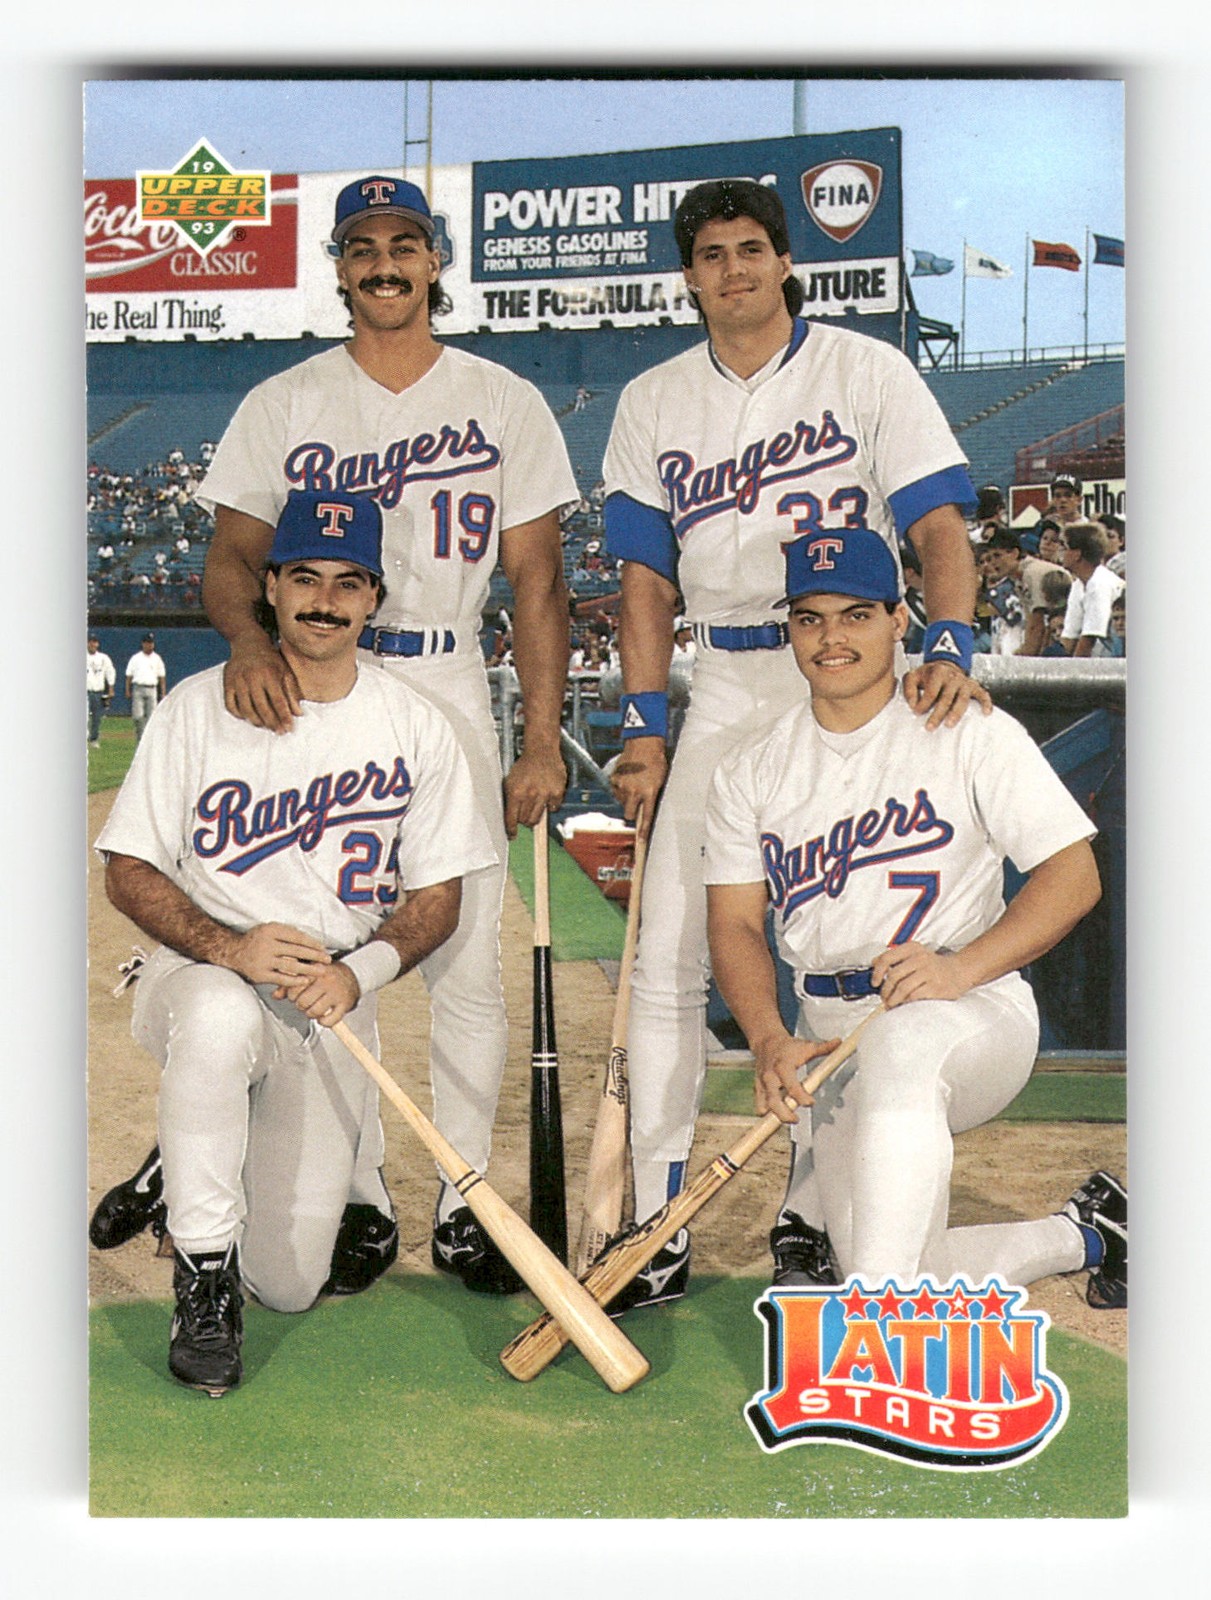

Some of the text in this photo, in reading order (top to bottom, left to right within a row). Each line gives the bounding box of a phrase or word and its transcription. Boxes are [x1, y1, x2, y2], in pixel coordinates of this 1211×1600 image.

[192, 161, 215, 173] 19
[143, 178, 264, 195] UPPER
[361, 179, 396, 206] T
[813, 183, 871, 208] FINA
[483, 185, 623, 231] POWER
[191, 222, 215, 235] 93
[483, 230, 648, 258] GENESIS GASOLINES
[170, 251, 257, 276] CLASSIC
[483, 251, 648, 272] FROM YOUR FRIENDS AT FINA
[114, 300, 158, 330] Real
[162, 299, 226, 334] Thing.
[483, 289, 530, 319] THE
[537, 282, 667, 317] FORMULA
[284, 418, 500, 510] Rangers
[656, 409, 858, 526] Rangers
[316, 502, 354, 537] T
[430, 489, 497, 564] 19
[807, 537, 844, 572] T
[192, 755, 415, 866] Rangers
[760, 788, 955, 914] Rangers
[888, 870, 941, 950] 7
[768, 1296, 1042, 1404] LATIN
[799, 1387, 1002, 1440] STARS
